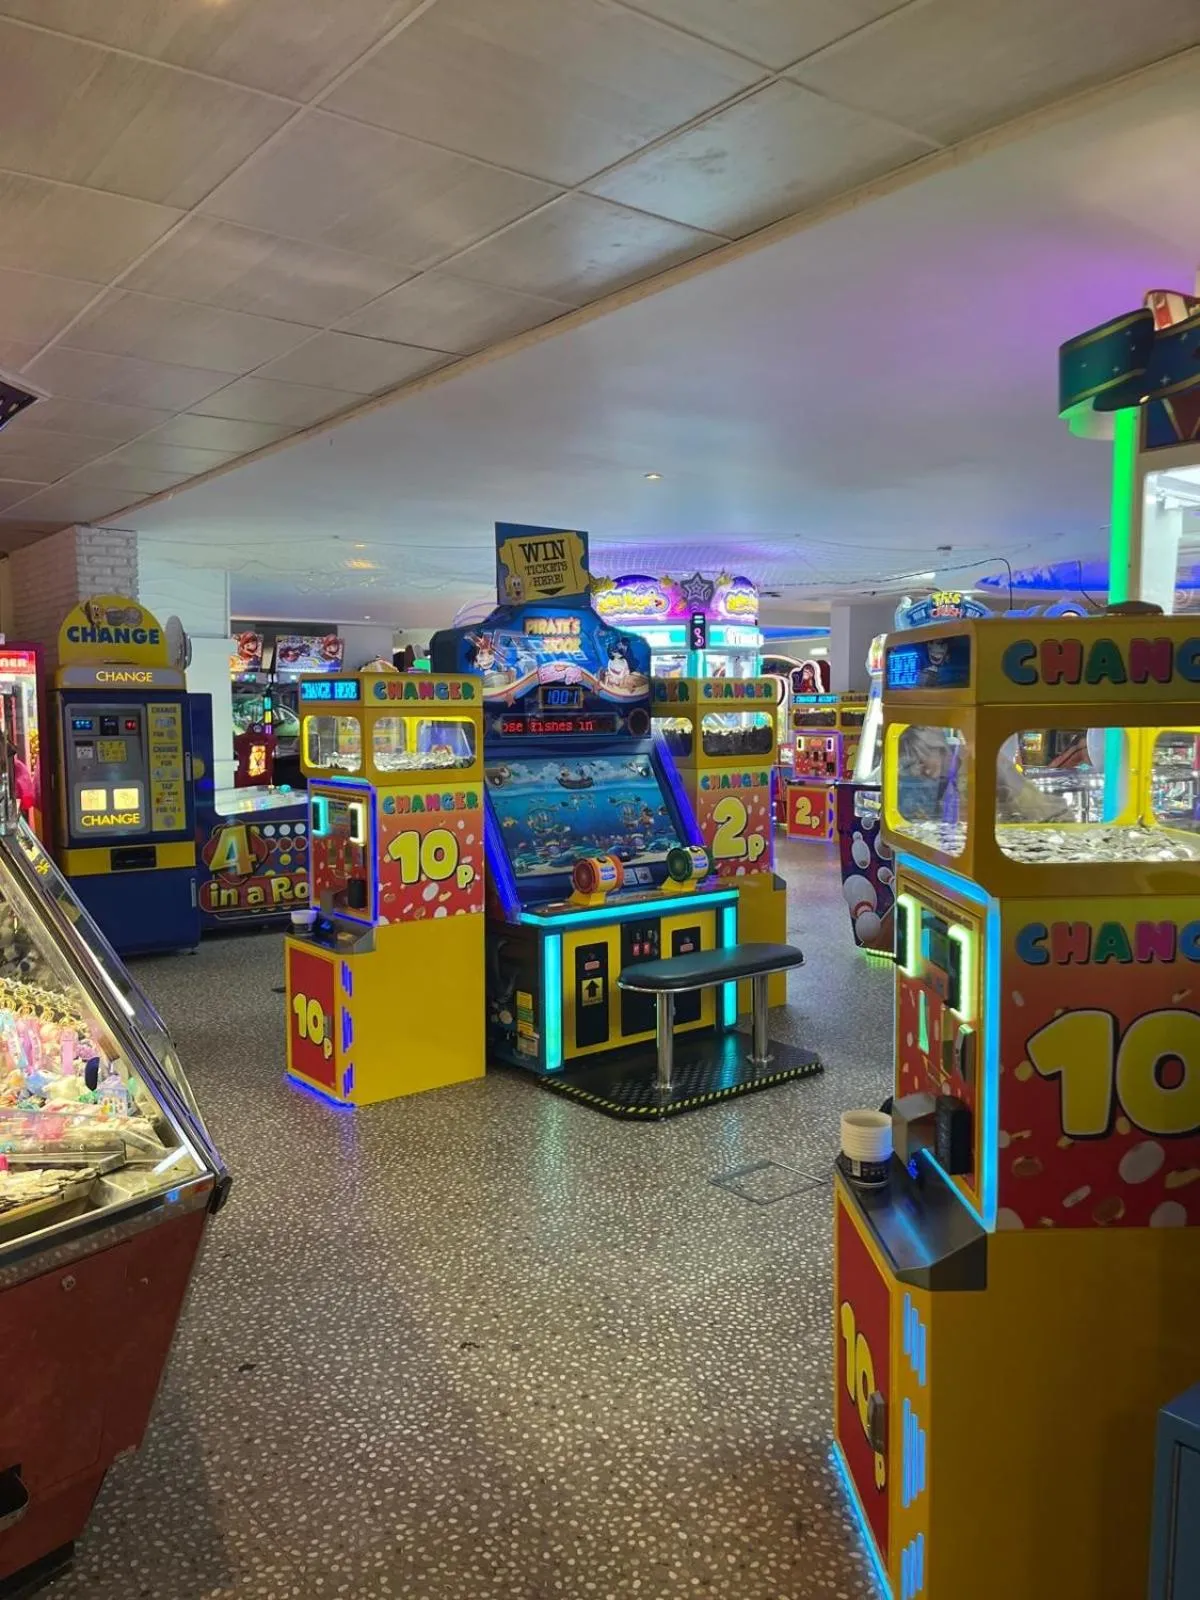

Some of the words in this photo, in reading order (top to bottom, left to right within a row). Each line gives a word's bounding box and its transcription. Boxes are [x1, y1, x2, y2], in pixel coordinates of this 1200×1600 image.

[518, 539, 565, 563] WIN
[523, 561, 569, 576] TICKETS
[531, 574, 564, 588] HERE!
[66, 625, 161, 645] CHANGE
[524, 617, 581, 635] PIRATE'S
[95, 670, 153, 683] CHANGE
[373, 680, 475, 700] CHANGER
[703, 682, 773, 699] CHANGER
[701, 771, 769, 791] CHANGER
[382, 790, 479, 815] CHANGER
[795, 796, 820, 829] 2p
[81, 812, 141, 826] CHANGE
[712, 796, 766, 864] 2p
[208, 824, 257, 876] 4
[387, 828, 476, 889] 10p
[210, 882, 239, 907] in
[247, 886, 265, 905] a
[292, 991, 333, 1061] 10p
